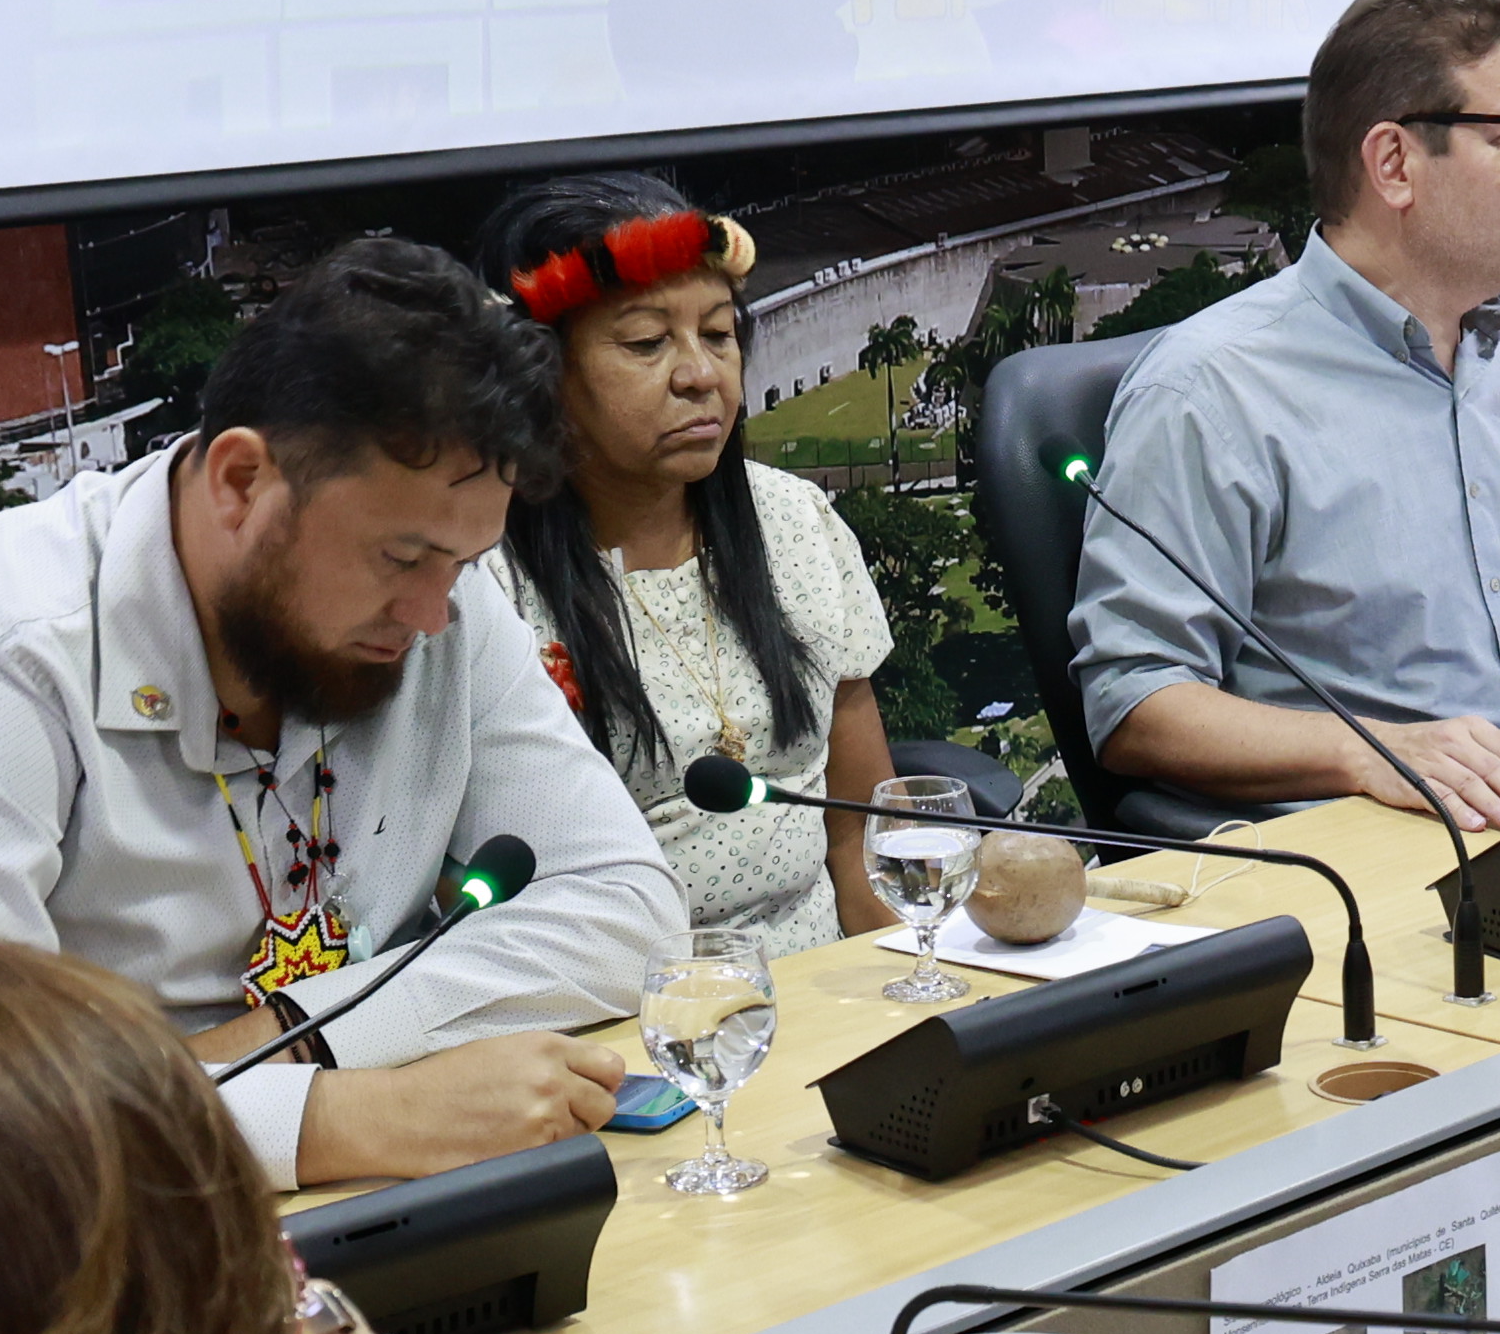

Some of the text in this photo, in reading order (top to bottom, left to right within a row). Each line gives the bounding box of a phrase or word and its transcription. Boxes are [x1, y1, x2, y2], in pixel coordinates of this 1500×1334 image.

[1306, 1290, 1329, 1307] Terra
[1330, 1273, 1367, 1301] Indígena
[1368, 1267, 1391, 1283] Serra
[1392, 1259, 1406, 1273] das
[1408, 1249, 1432, 1269] Matas
[1438, 1238, 1455, 1255] CE)
[1316, 1269, 1342, 1287] Aldeia
[1347, 1253, 1382, 1274] Quixaba
[1386, 1233, 1431, 1263] (municípios
[1435, 1225, 1447, 1238] de
[1451, 1216, 1476, 1232] Santa
